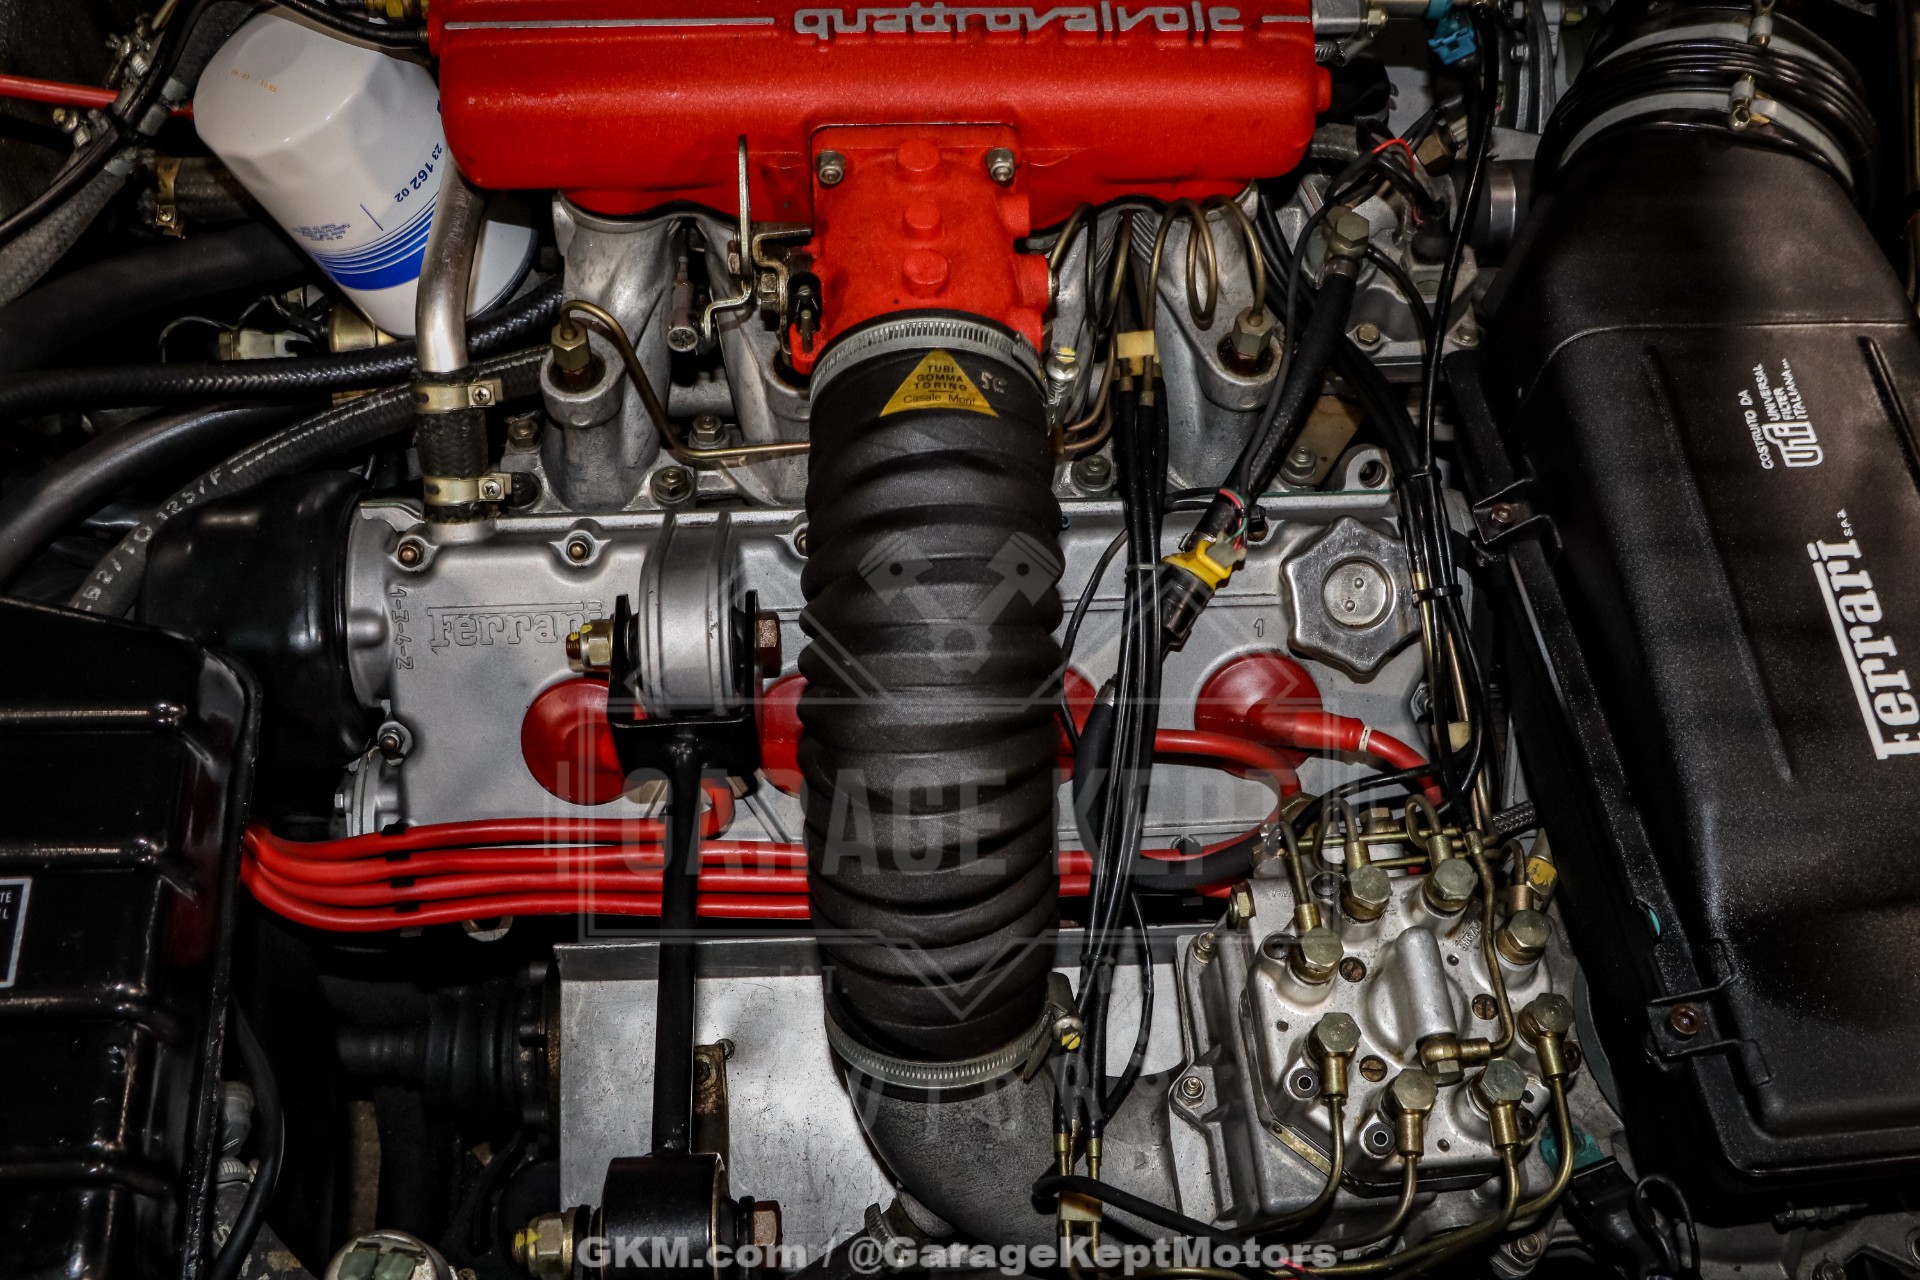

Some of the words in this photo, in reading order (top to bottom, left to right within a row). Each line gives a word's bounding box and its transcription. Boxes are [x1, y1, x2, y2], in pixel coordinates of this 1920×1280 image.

[431, 143, 443, 161] 23
[409, 162, 434, 190] 162
[394, 187, 410, 203] 02
[927, 365, 954, 373] TUBI
[914, 382, 967, 391] TORINO
[916, 374, 963, 382] GOMMA
[903, 393, 941, 404] Casale
[1738, 389, 1753, 405] DA
[1752, 363, 1781, 421] UNIVERSAL
[1781, 369, 1808, 419] ITALIANA
[1773, 387, 1795, 420] FILTER
[1807, 538, 1920, 760] Ferrari
